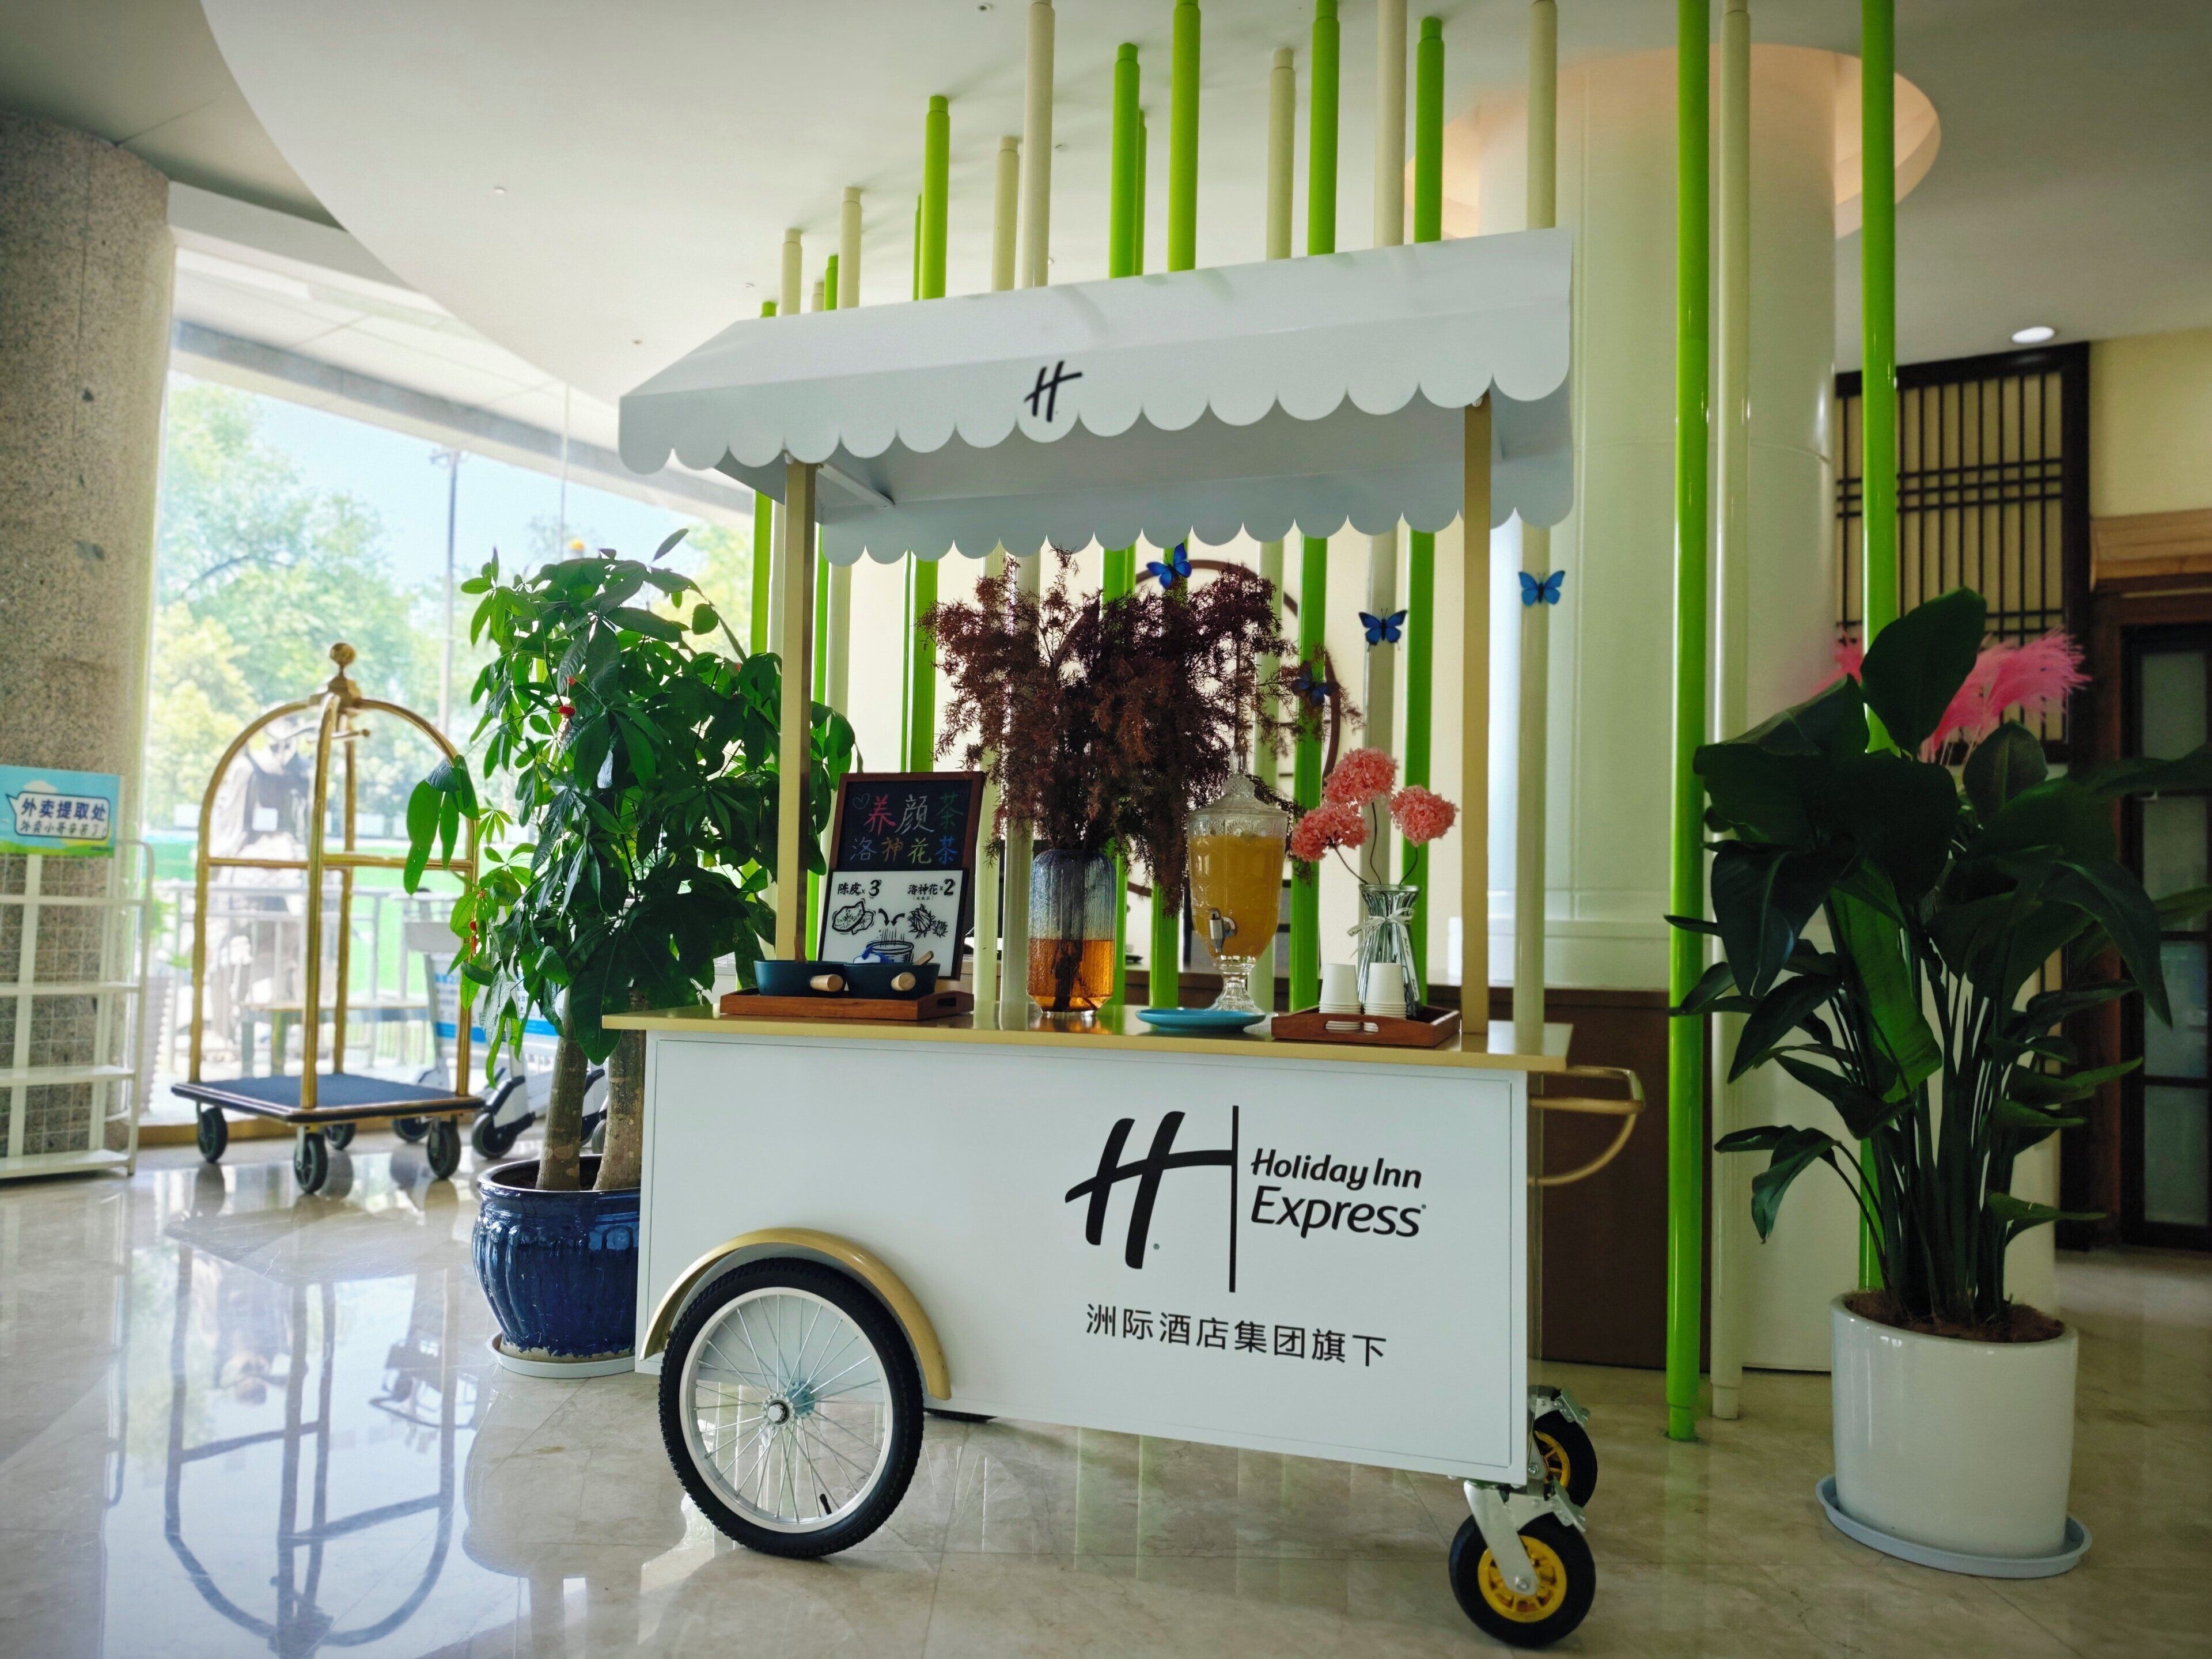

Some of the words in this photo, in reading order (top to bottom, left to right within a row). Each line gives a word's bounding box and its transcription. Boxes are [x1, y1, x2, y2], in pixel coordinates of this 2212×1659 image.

[21, 797, 105, 821] 外卖提取处
[863, 793, 964, 836] 养颜茶
[850, 835, 959, 865] 洛神花茶
[1251, 1148, 1369, 1191] Holiday
[1373, 1158, 1422, 1189] Inn
[1251, 1185, 1421, 1238] Express
[1086, 1303, 1387, 1368] 洲际酒店集团旗下
